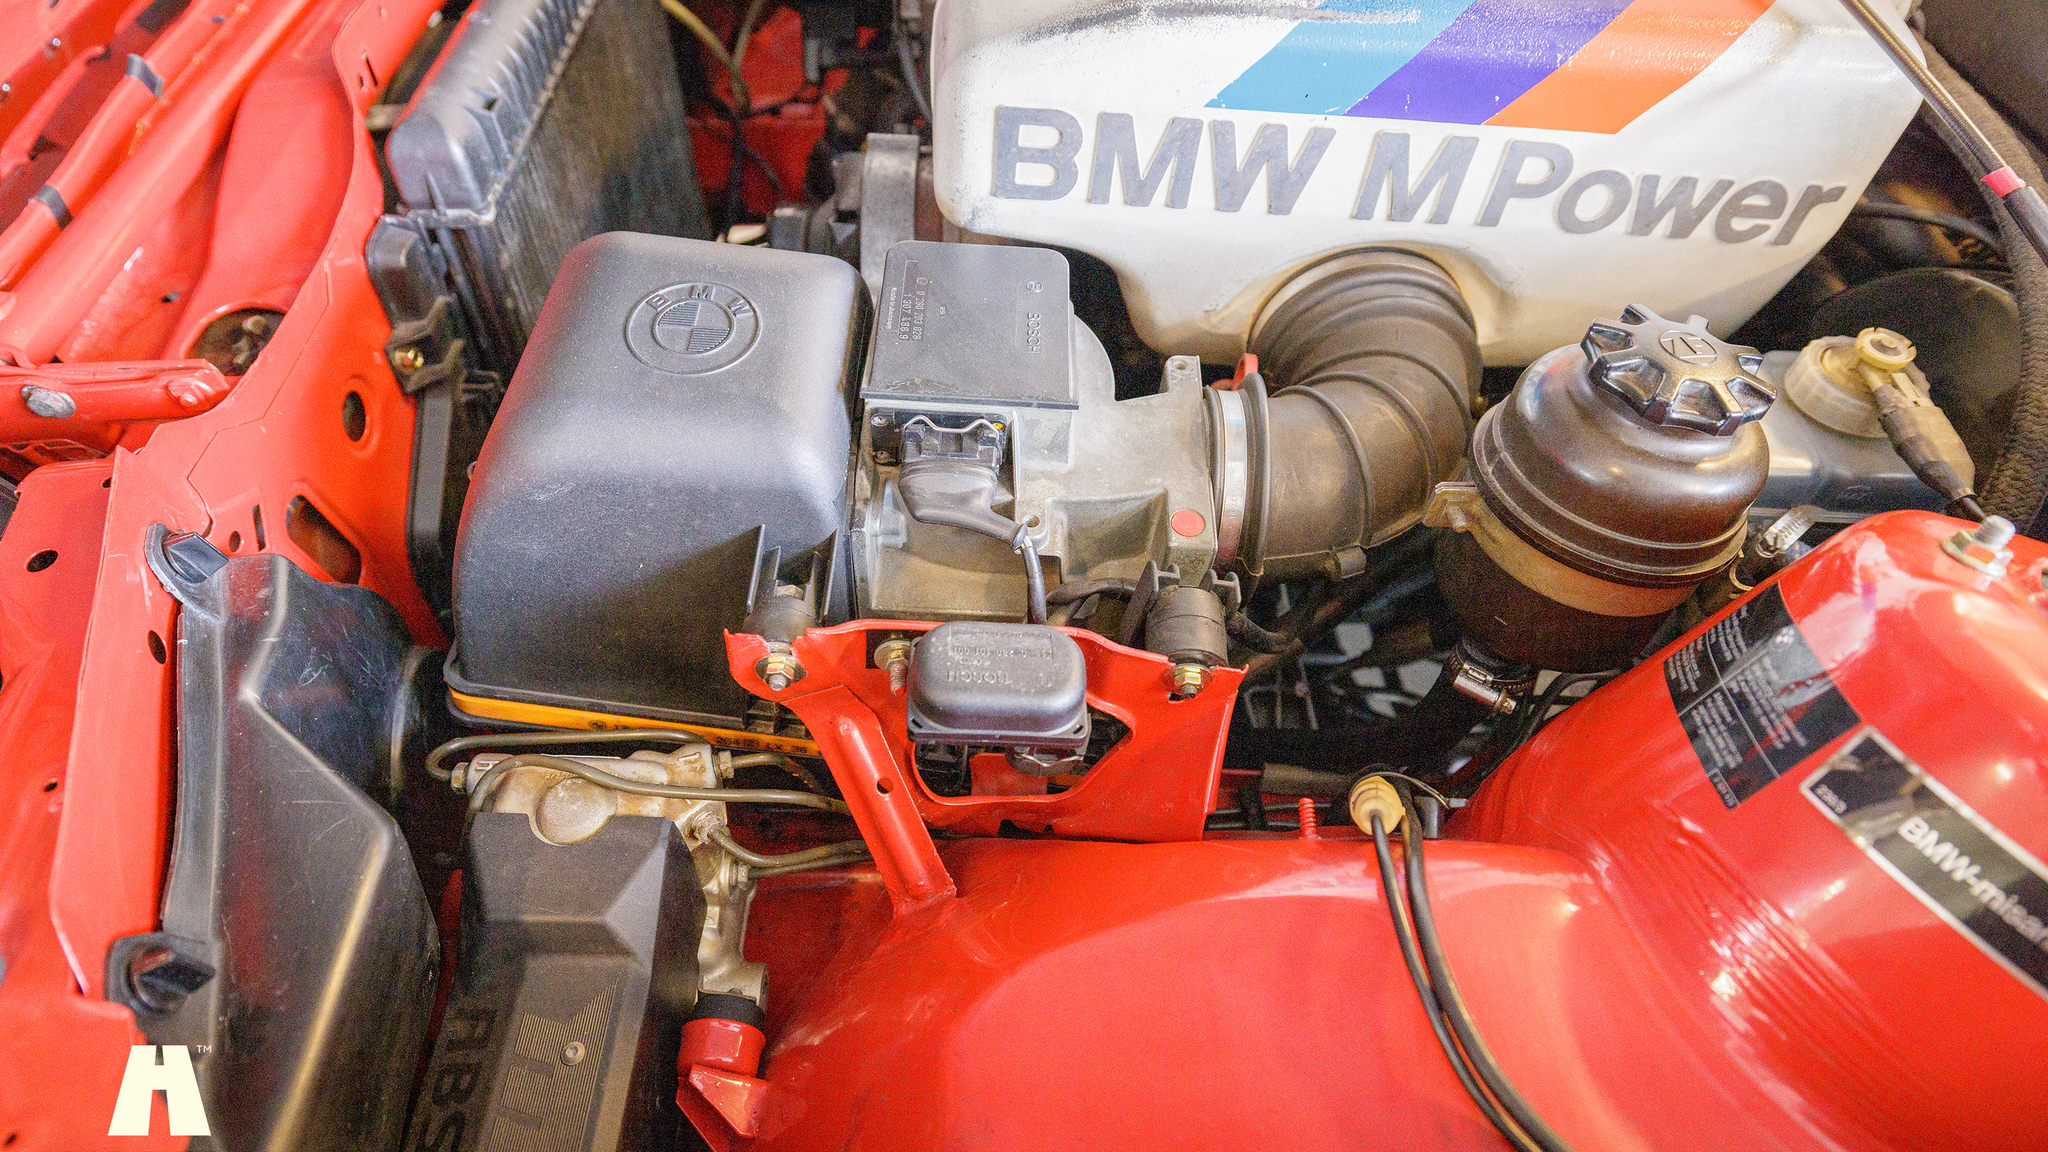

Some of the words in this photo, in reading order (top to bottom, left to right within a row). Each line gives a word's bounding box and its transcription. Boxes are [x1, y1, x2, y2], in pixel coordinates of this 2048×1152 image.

[993, 104, 1337, 216] BMW
[1026, 312, 1041, 354] BOSCH
[947, 668, 1008, 685] BOSCH
